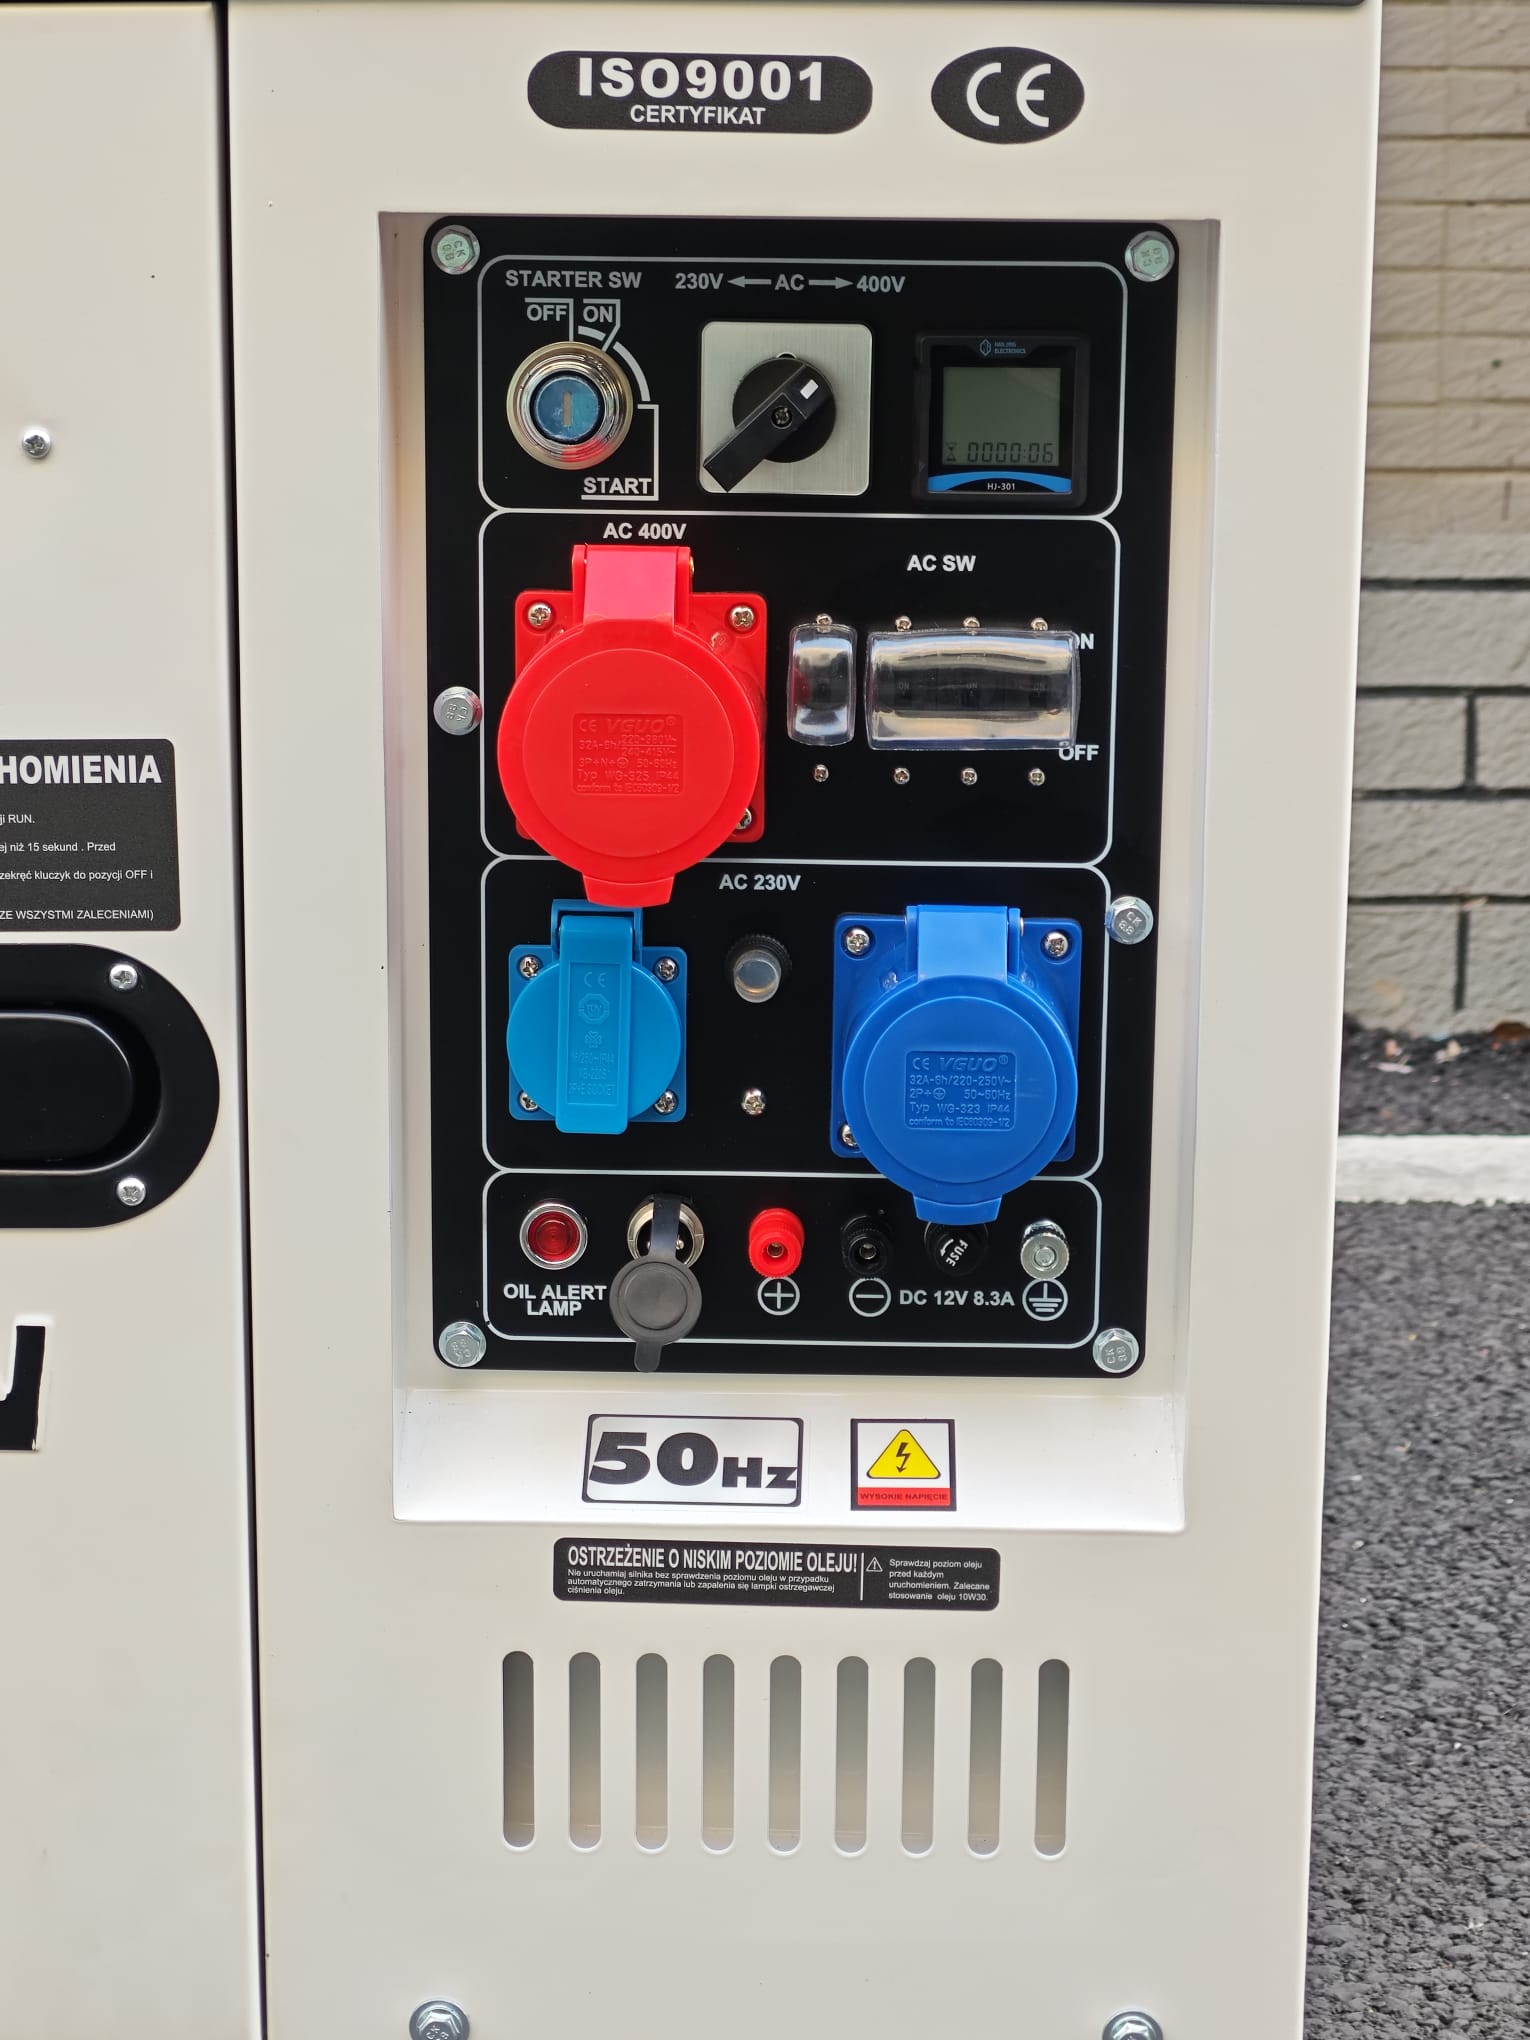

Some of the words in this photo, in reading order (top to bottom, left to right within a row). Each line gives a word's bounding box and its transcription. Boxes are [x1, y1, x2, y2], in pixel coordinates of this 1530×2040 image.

[578, 57, 822, 102] ISO9001
[966, 62, 1051, 127] CE
[630, 105, 766, 125] CERTYFIKAT
[505, 270, 603, 289] STARTER
[608, 271, 642, 289] SW
[675, 273, 724, 290] 230V
[775, 274, 805, 291] AC
[856, 276, 906, 293] 400V
[526, 305, 567, 322] OFF
[582, 306, 614, 323] ON
[967, 442, 1054, 463] 0000:06
[583, 477, 653, 495] START
[987, 482, 1016, 491] HJ-301
[603, 522, 633, 539] AC
[638, 523, 687, 540] 400V
[907, 555, 937, 571] AC
[942, 555, 976, 572] SW
[1059, 744, 1099, 761] OFF
[0, 754, 163, 784] HOMIENIA
[8, 814, 36, 824] RUN.
[10, 842, 25, 852] niż
[28, 842, 40, 852] 15
[42, 842, 78, 852] sekund
[87, 842, 116, 852] Przed
[34, 870, 71, 881] kluczyk
[74, 870, 86, 880] do
[89, 870, 123, 882] pozycji
[125, 870, 147, 880] OFF
[719, 873, 748, 890] AC
[753, 874, 801, 891] 230V
[15, 910, 74, 920] WSZYSTMI
[77, 910, 154, 921] ZALECENIAMI)
[912, 1057, 930, 1071] CE
[908, 1101, 931, 1115] Typ
[936, 1103, 981, 1114] WG-323
[987, 1104, 1011, 1114] IP44
[945, 1239, 969, 1267] FUSE
[503, 1283, 537, 1299] OIL
[541, 1284, 607, 1301] ALERT
[899, 1289, 928, 1305] DC
[934, 1290, 969, 1306] 12V
[973, 1290, 1015, 1306] 8.3A
[527, 1300, 582, 1317] LAMP
[905, 1493, 947, 1501] NAPIĘCIE
[568, 1544, 665, 1568] OSTRZEŻENIE
[668, 1548, 680, 1568] O
[683, 1549, 731, 1569] NISKIM
[735, 1550, 803, 1572] POZIOMIE
[807, 1552, 857, 1573] OLEJU!
[889, 1559, 931, 1568] Sprawdzaj
[932, 1560, 961, 1569] poziom
[963, 1560, 982, 1570] oleju
[568, 1569, 581, 1577] Nie
[583, 1569, 626, 1579] uruchamiaj
[629, 1570, 653, 1578] silnika
[655, 1571, 669, 1579] bez
[671, 1572, 721, 1580] sprawdzenia
[723, 1573, 756, 1581] poziomu
[758, 1573, 777, 1583] oleju
[788, 1575, 829, 1584] przypadku
[889, 1570, 911, 1578] przed
[913, 1570, 944, 1580] każdym
[567, 1578, 632, 1588] automatycznego
[634, 1580, 681, 1588] zatrzymania
[697, 1581, 735, 1590] zapalenia
[737, 1582, 749, 1591] się
[751, 1583, 777, 1591] lampki
[779, 1584, 835, 1593] ostrzegawczej
[567, 1586, 602, 1594] ciśnienia
[603, 1587, 625, 1596] oleju.
[953, 1581, 990, 1590] Zalecane
[888, 1592, 933, 1600] stosowanie
[937, 1593, 956, 1602] oleju
